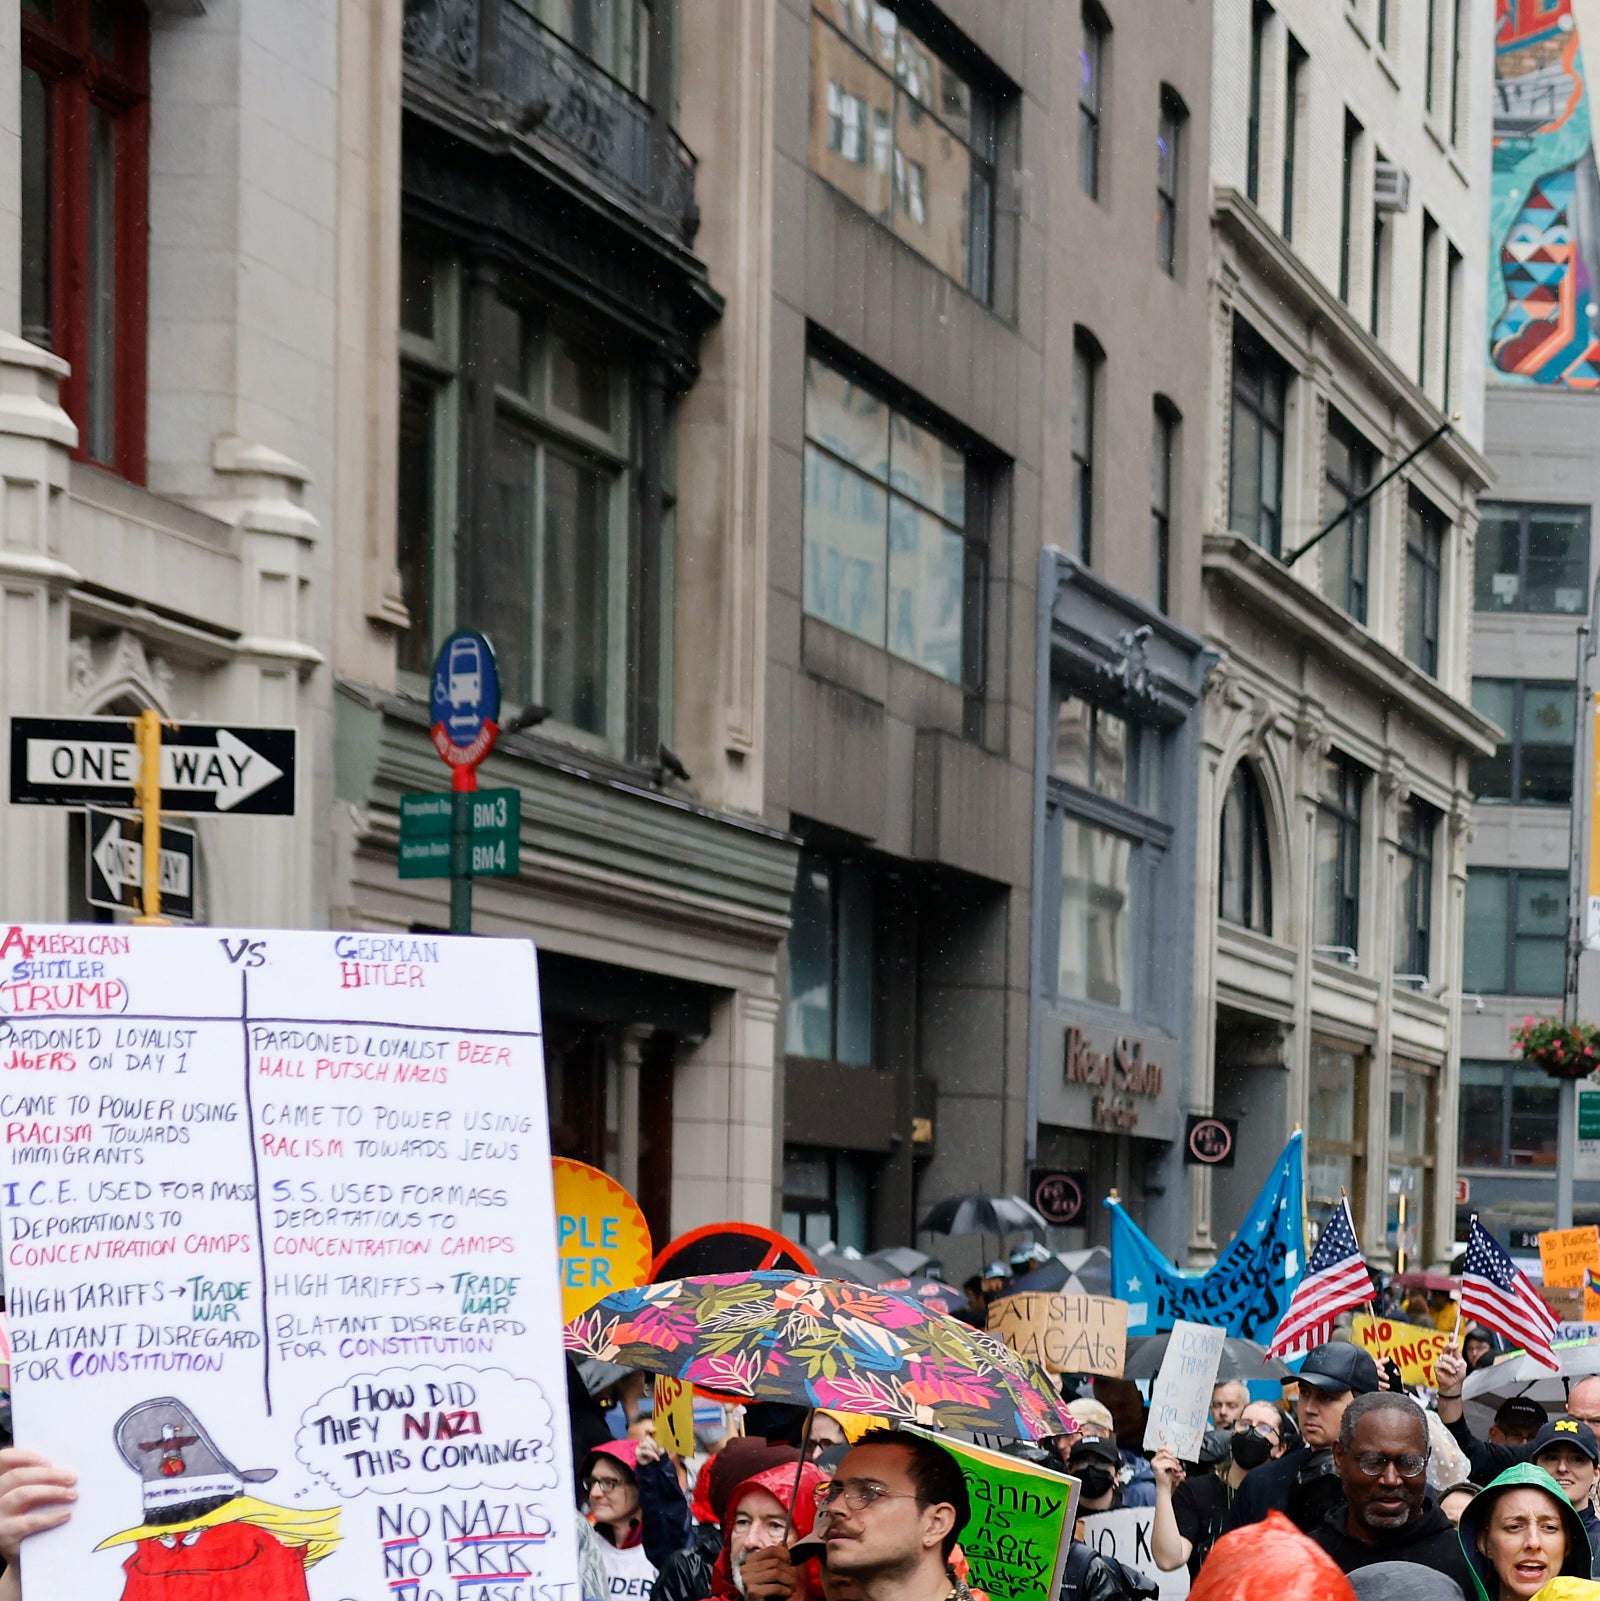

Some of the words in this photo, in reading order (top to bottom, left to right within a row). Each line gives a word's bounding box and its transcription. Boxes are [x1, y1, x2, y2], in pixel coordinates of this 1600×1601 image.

[51, 747, 131, 781] ONE
[171, 752, 253, 787] WAY
[473, 797, 507, 829] BM3
[105, 844, 135, 882] ONE
[472, 840, 506, 871] BM4
[1, 926, 130, 959] AMERICAN
[334, 936, 439, 963] GERMAN
[12, 961, 105, 981] SHITLER
[340, 961, 425, 988] HITLER
[0, 1022, 101, 1050] PARDONED
[116, 1029, 197, 1049] LOYALIST
[251, 1026, 359, 1055] PARDONED
[364, 1036, 450, 1060] LOYALIST
[457, 1040, 511, 1067] BEER
[4, 1050, 77, 1072] J6ERS
[89, 1054, 112, 1071] ON
[126, 1053, 166, 1073] DAY
[175, 1053, 187, 1074] 1
[258, 1056, 304, 1078] HALL
[315, 1059, 388, 1082] PUTSCH
[394, 1064, 448, 1084] NAZIS
[1, 1094, 57, 1117] CAME
[67, 1095, 90, 1116] TO
[98, 1095, 175, 1122] POWER
[182, 1102, 238, 1123] USING
[262, 1103, 324, 1127] CAME
[332, 1105, 363, 1127] TO
[373, 1105, 453, 1131] POWER
[463, 1111, 532, 1133] USING
[5, 1122, 92, 1144] RACISM
[101, 1123, 190, 1144] TOWARDS
[261, 1133, 344, 1158] RACISM
[353, 1139, 448, 1158] TOWARDS
[457, 1140, 519, 1161] JEWS
[11, 1145, 144, 1165] IMMIGRANTS
[88, 1180, 151, 1202] USED
[160, 1181, 204, 1200] FOR
[211, 1181, 258, 1202] MASS
[330, 1183, 393, 1204] USED
[400, 1184, 442, 1205] FOR
[448, 1185, 508, 1207] MASS
[9, 1211, 154, 1241] DEPORTATIONS
[160, 1210, 182, 1228] TO
[273, 1208, 422, 1229] DEPORTATIONS
[428, 1213, 455, 1229] TO
[9, 1236, 176, 1267] CONCENTRATION
[184, 1234, 250, 1254] CAMPS
[273, 1236, 431, 1258] CONCENTRATION
[440, 1235, 515, 1256] CAMPS
[10, 1286, 66, 1317] HIGH
[70, 1280, 164, 1312] TARIFFS
[186, 1275, 252, 1302] TRADE
[274, 1273, 328, 1297] HIGH
[333, 1274, 421, 1298] TARIFFS
[450, 1271, 521, 1297] TRADE
[192, 1303, 240, 1322] WAR
[460, 1295, 511, 1316] WAR
[1048, 1294, 1115, 1327] SHIT
[10, 1323, 128, 1353] BLATANT
[135, 1322, 260, 1349] DISREGARD
[276, 1314, 383, 1338] BLATANT
[391, 1314, 526, 1337] DISREGARD
[1363, 1322, 1392, 1347] NO
[277, 1340, 326, 1361] FOR
[339, 1336, 495, 1358] CONSTITUTION
[1377, 1334, 1446, 1370] KINGS
[12, 1357, 64, 1383] FOR
[69, 1351, 224, 1378] CONSTITUTION
[352, 1384, 415, 1412] HOW
[428, 1382, 476, 1407] DID
[312, 1415, 379, 1446] THEY
[402, 1410, 482, 1441] NAZI
[344, 1449, 411, 1478] THIS
[421, 1439, 543, 1472] COMING?
[379, 1504, 430, 1539] NO
[985, 1504, 1011, 1529] is
[977, 1526, 1040, 1560] not
[383, 1546, 432, 1579] NO
